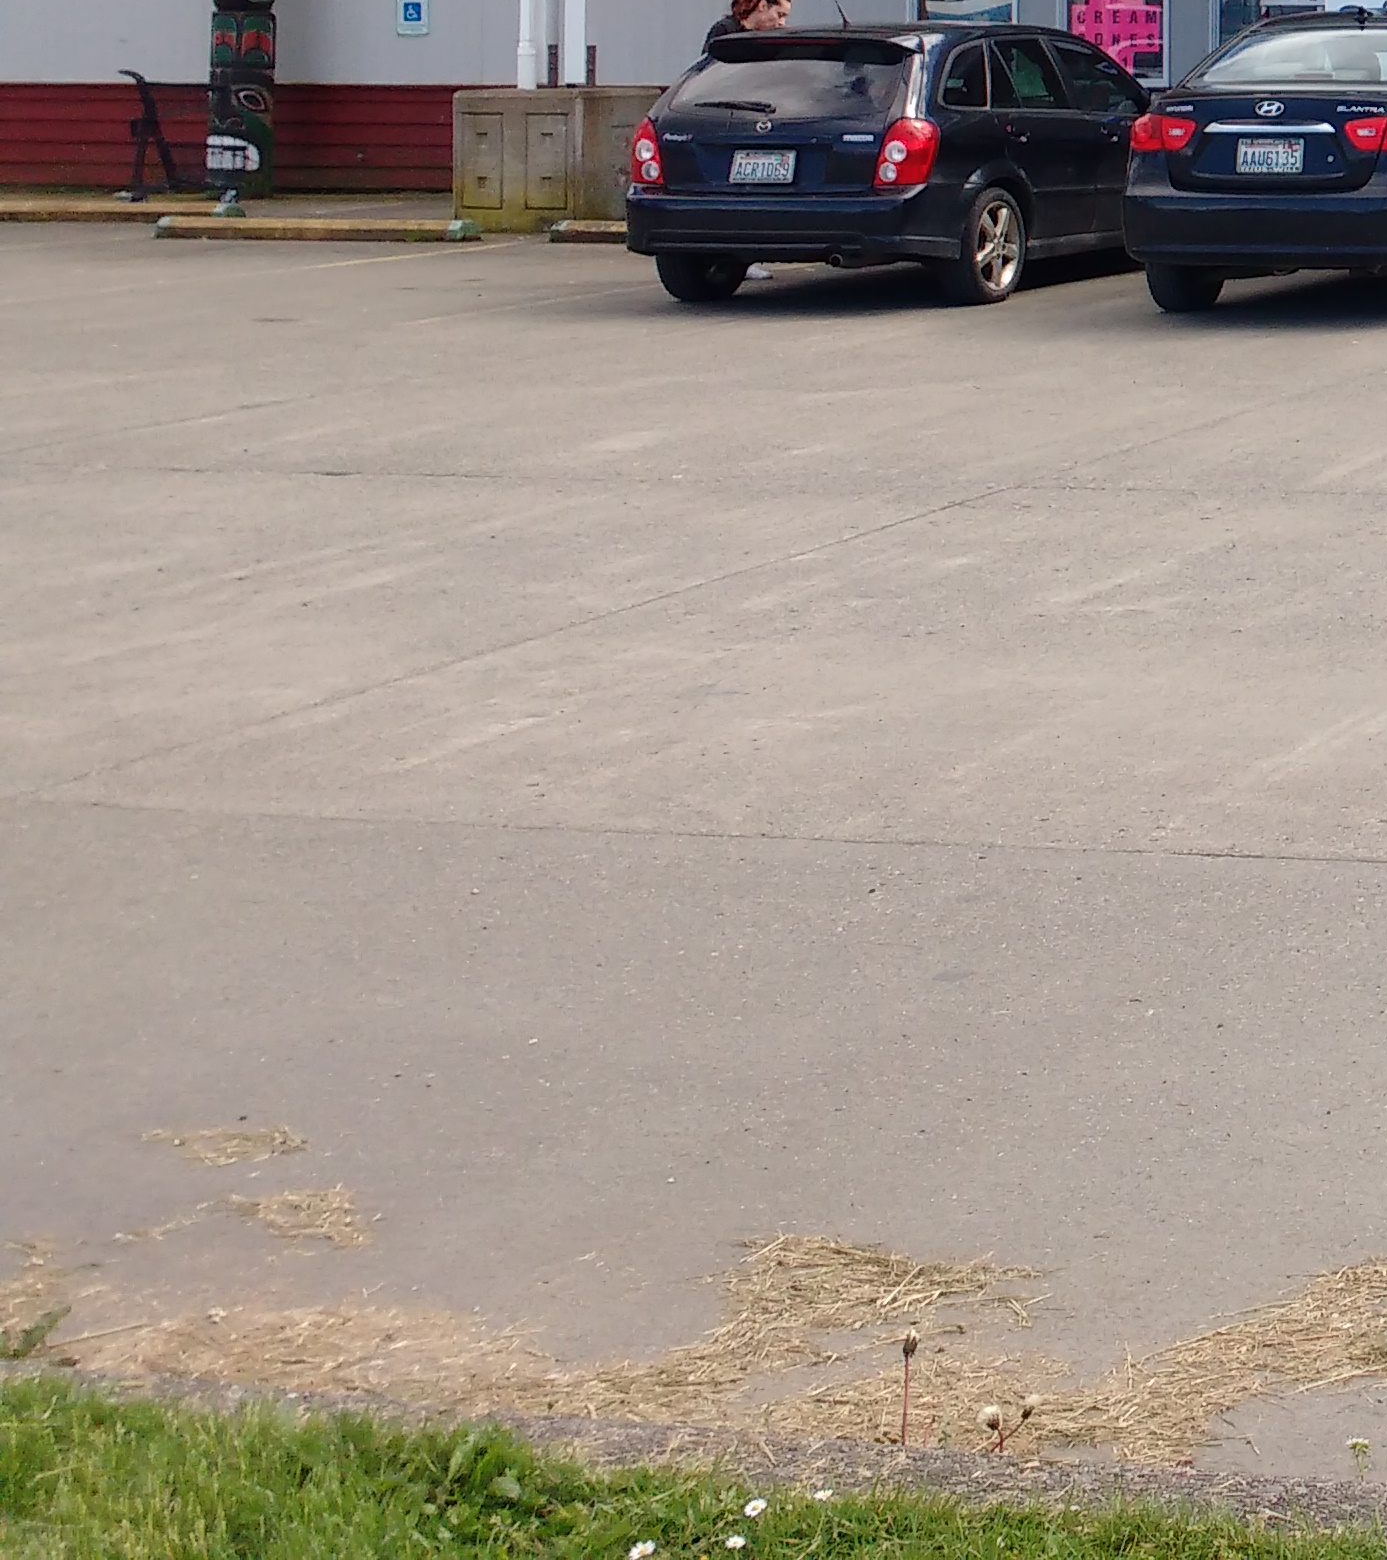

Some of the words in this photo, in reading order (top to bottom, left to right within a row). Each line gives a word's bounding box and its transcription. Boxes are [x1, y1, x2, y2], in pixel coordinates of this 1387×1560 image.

[1077, 10, 1157, 24] CREAM
[1077, 32, 1157, 48] ONES
[1241, 150, 1298, 168] AAU6135
[735, 161, 790, 177] ACR1069
